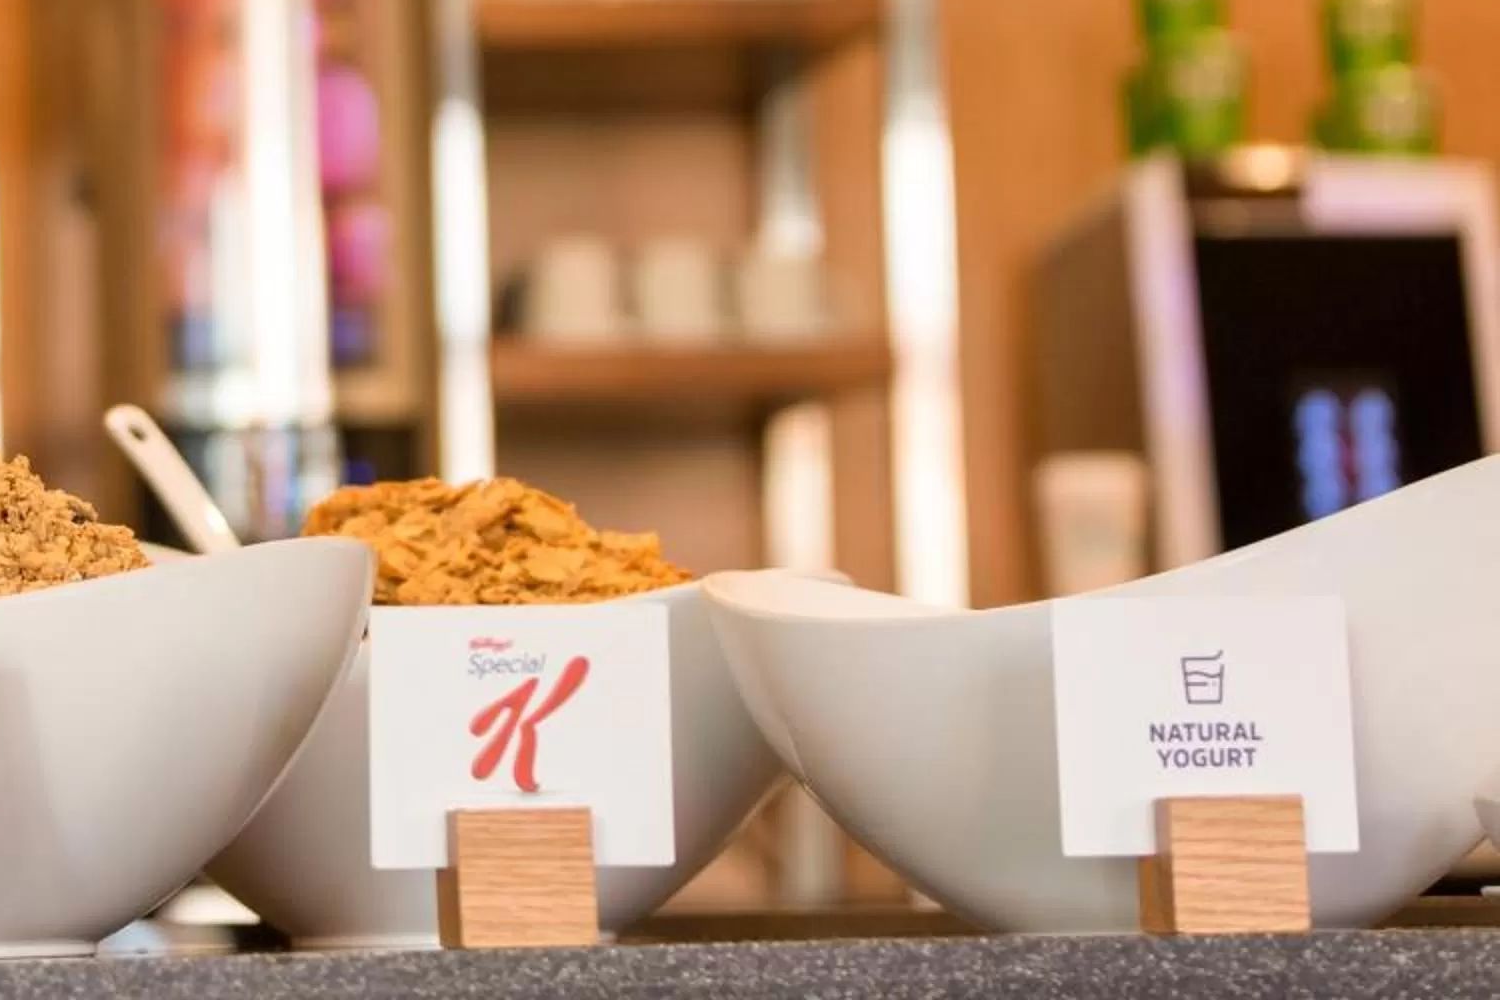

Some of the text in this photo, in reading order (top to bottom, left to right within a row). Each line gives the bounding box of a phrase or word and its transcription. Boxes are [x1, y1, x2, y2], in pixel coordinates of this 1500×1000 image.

[467, 651, 546, 679] Special
[469, 655, 590, 793] K
[1150, 722, 1262, 742] NATURAL
[1157, 748, 1256, 768] YOGURT
